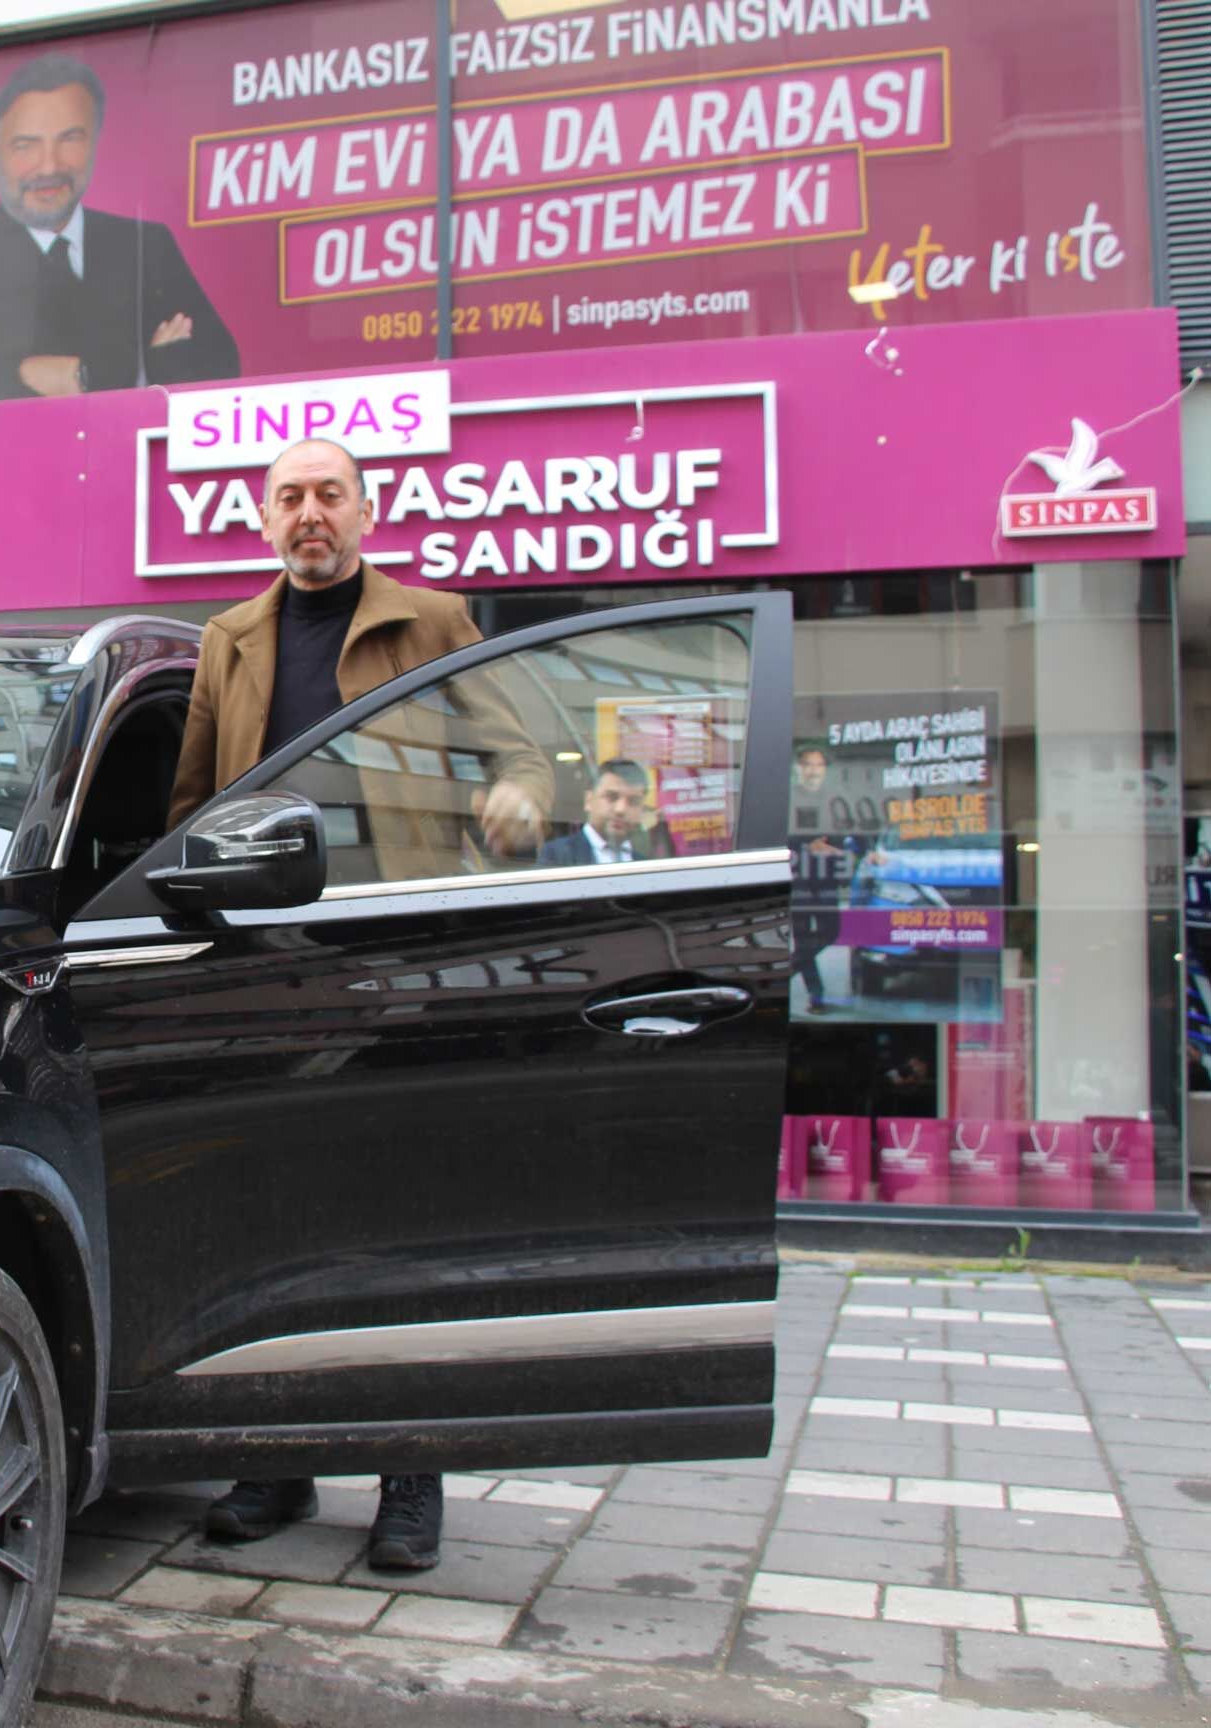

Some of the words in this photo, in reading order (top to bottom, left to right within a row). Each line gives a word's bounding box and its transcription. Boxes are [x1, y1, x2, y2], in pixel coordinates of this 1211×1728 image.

[233, 37, 429, 106] BANKASIZ
[452, 113, 520, 182] YA
[541, 102, 623, 172] DA
[639, 67, 927, 163] ARABASI
[313, 207, 500, 287] OLSUN
[362, 311, 423, 342] 0850
[489, 300, 544, 331] 1974
[566, 289, 750, 329] sinpasyts.com
[364, 448, 722, 524] TASARRUF
[420, 509, 715, 580] SANDIĞI
[829, 723, 842, 746] 5
